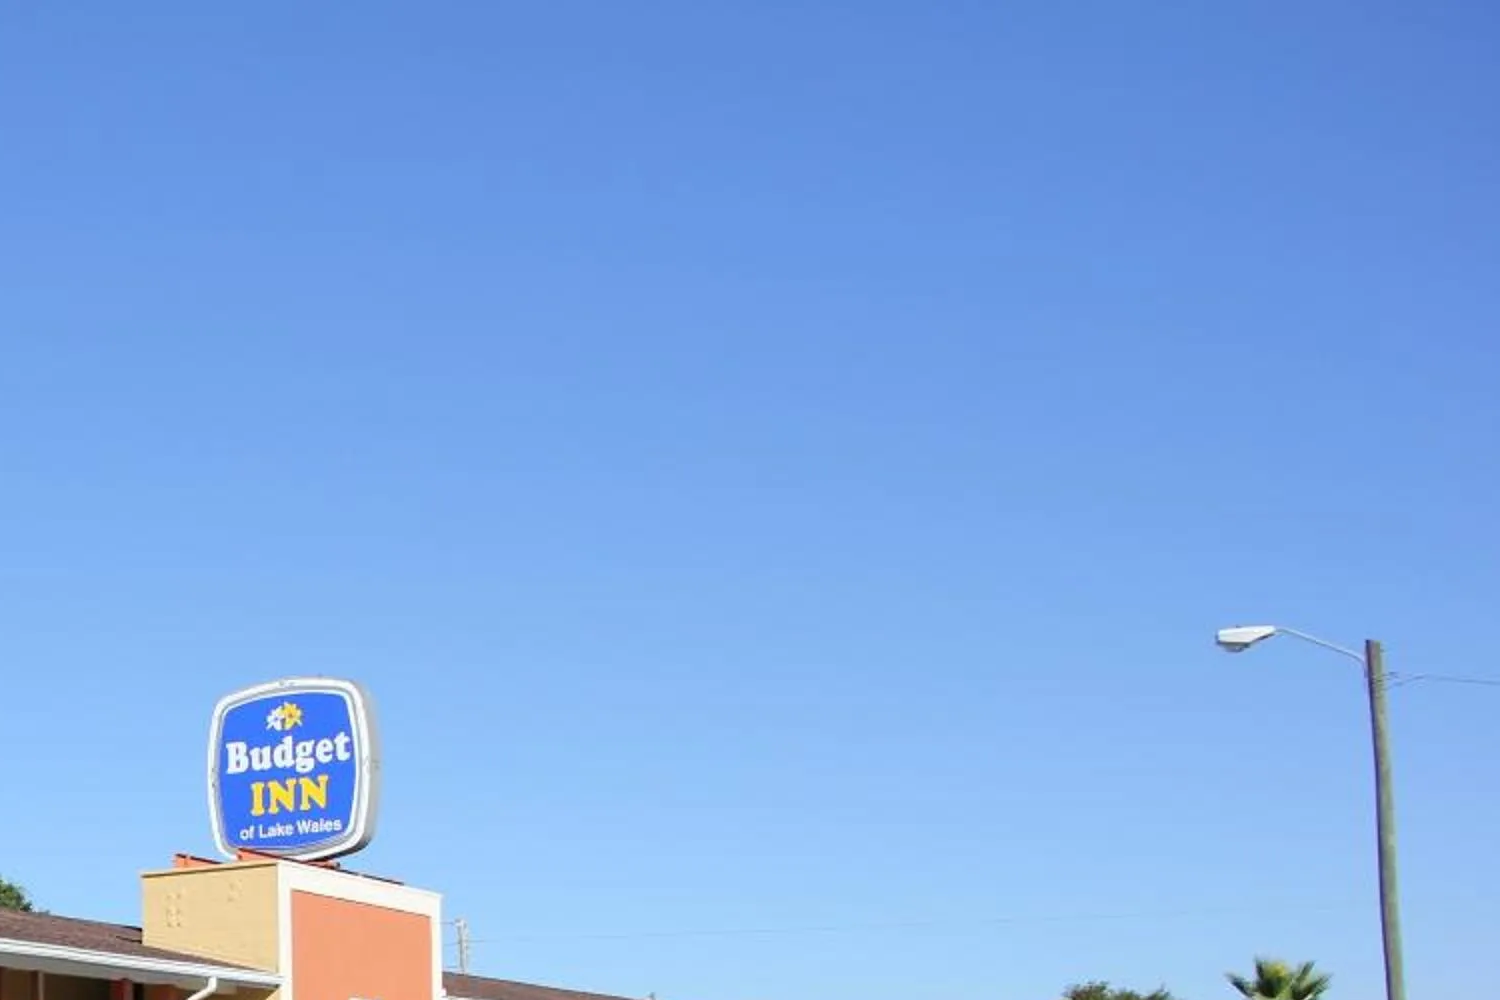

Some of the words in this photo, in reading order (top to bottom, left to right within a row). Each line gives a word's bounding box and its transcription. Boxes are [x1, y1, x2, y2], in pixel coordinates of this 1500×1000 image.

[225, 731, 350, 774] Budget
[250, 774, 329, 816] INN
[239, 825, 254, 840] of
[259, 821, 293, 839] Lake
[297, 818, 342, 835] Wales
